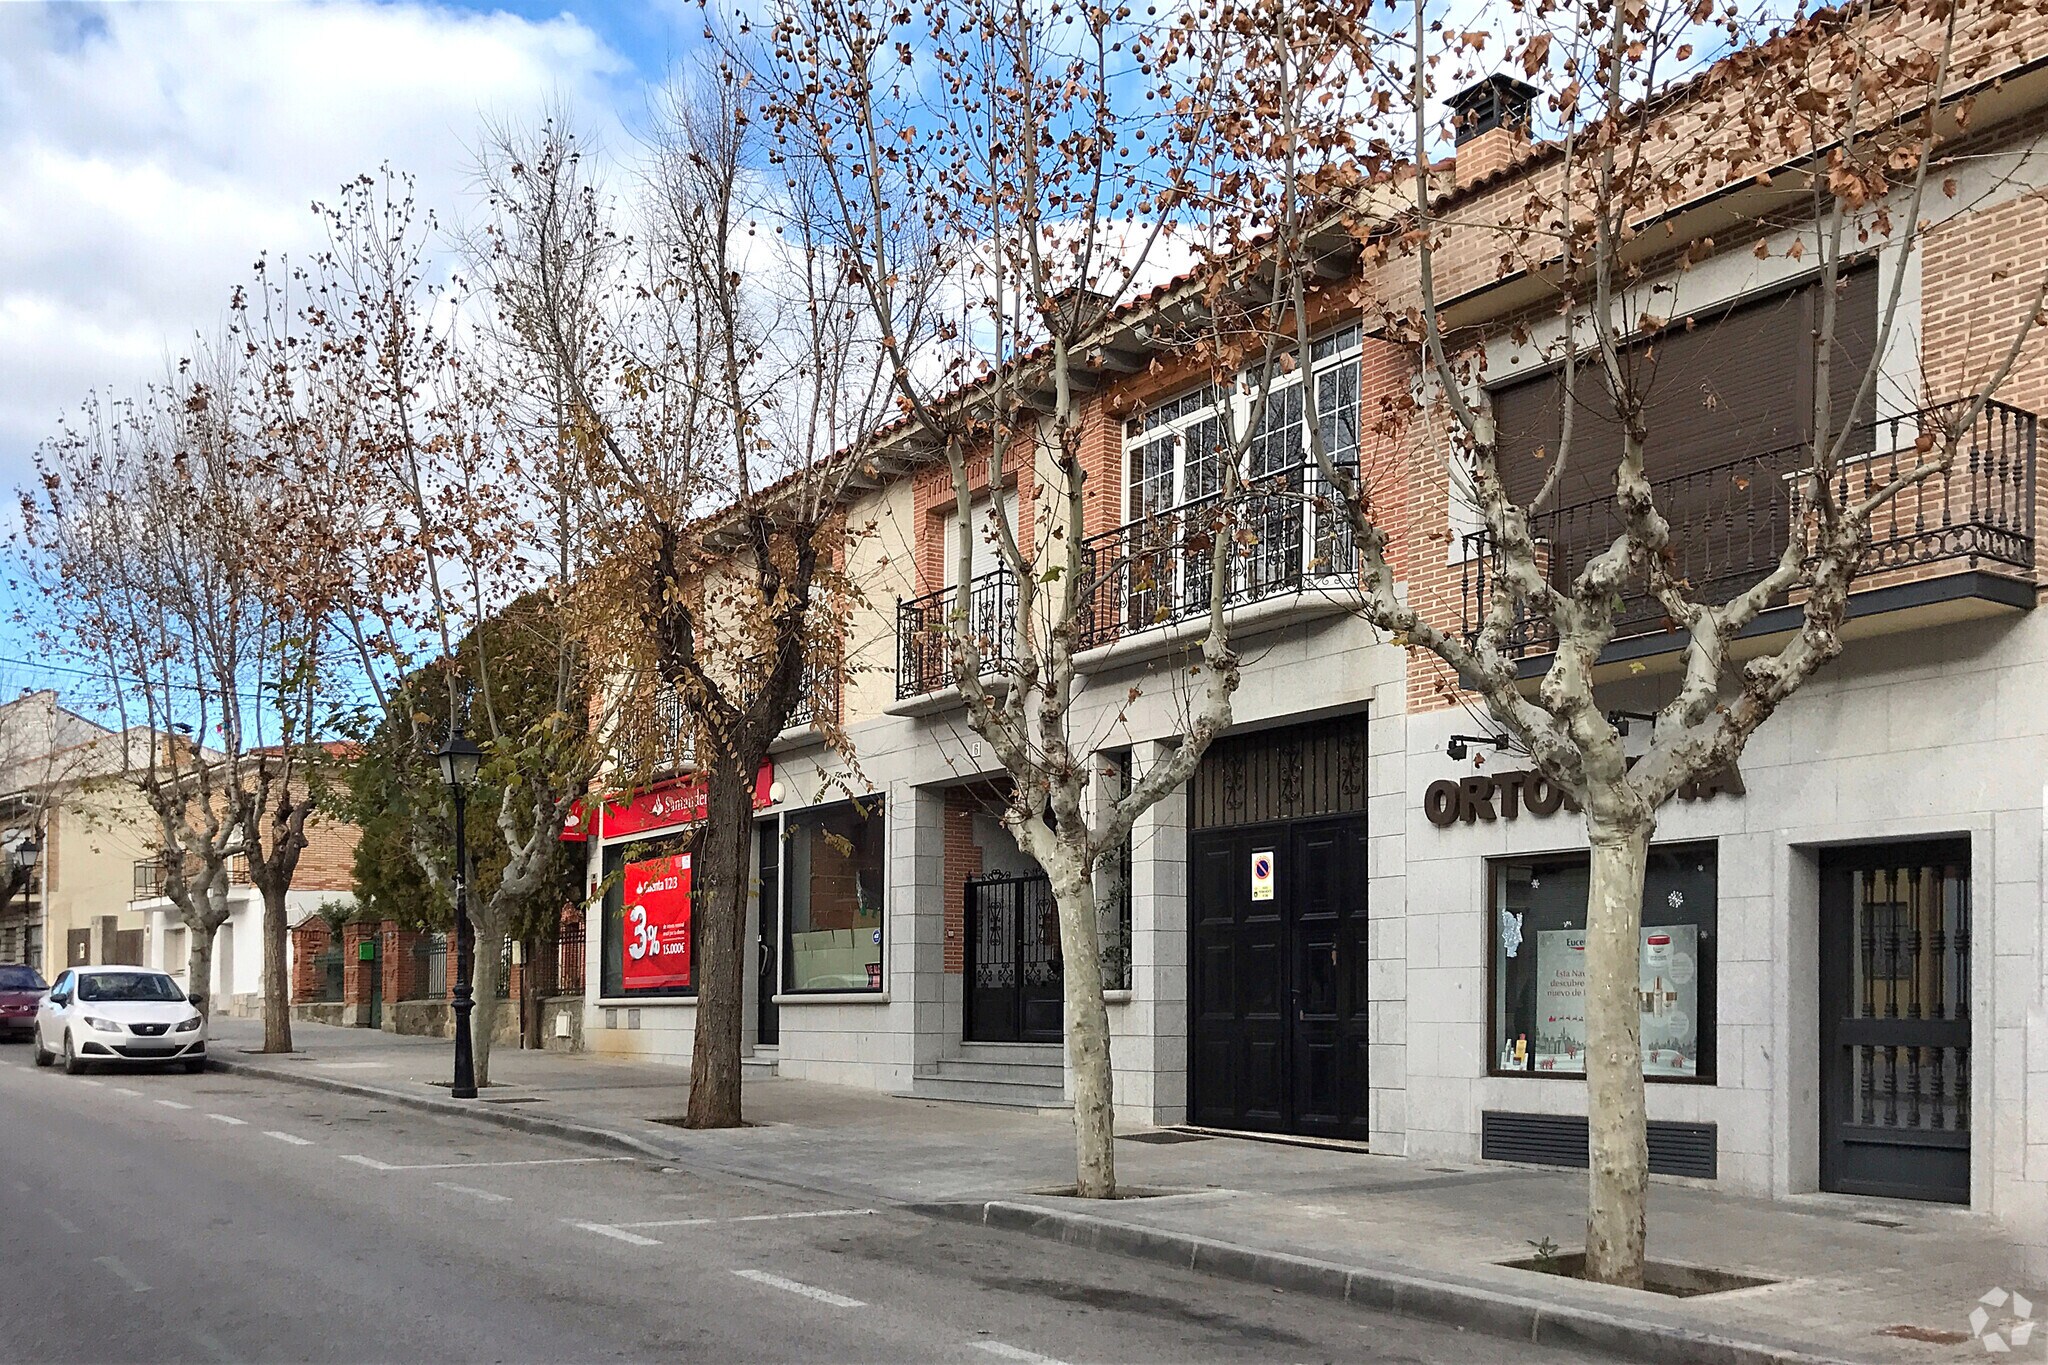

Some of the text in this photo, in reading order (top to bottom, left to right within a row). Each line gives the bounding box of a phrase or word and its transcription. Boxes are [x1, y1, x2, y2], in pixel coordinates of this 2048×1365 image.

[974, 743, 979, 755] 6
[664, 876, 678, 890] 123
[1566, 938, 1585, 946] Euce
[663, 942, 685, 955] 15.000€
